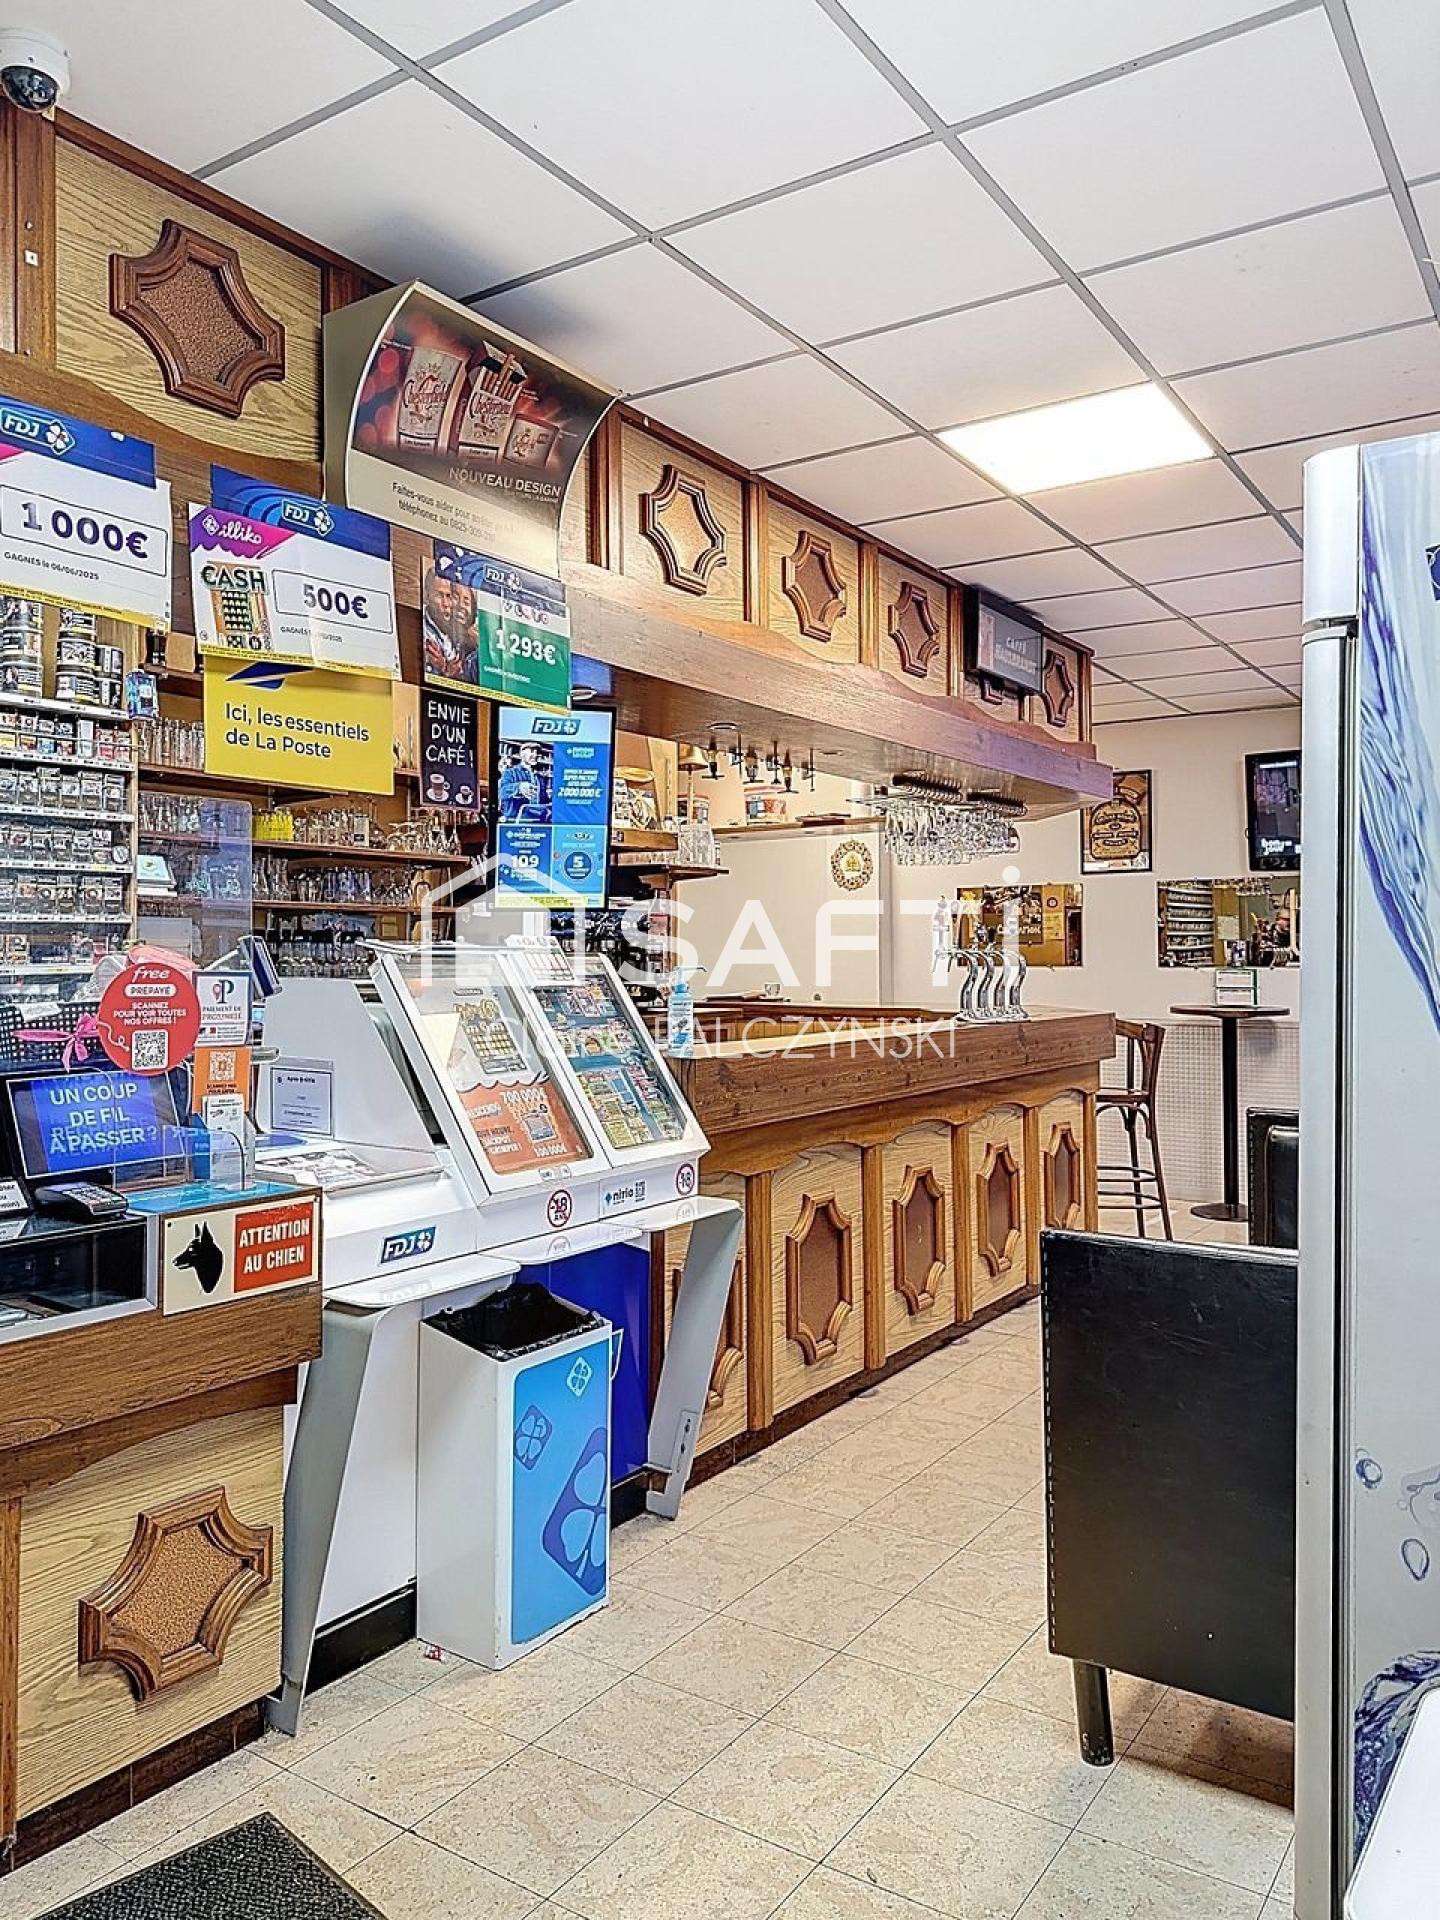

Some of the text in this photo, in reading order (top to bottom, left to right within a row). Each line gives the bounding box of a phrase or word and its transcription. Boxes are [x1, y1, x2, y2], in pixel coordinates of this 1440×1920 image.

[3, 415, 38, 436] FDJ
[451, 468, 562, 497] NOUVEAU DESIGN
[284, 505, 310, 523] FDJ
[51, 510, 148, 558] 000€
[217, 520, 262, 545] illiko
[486, 568, 505, 583] FDJ
[303, 584, 368, 619] 500€
[509, 633, 556, 666] 293€
[226, 702, 370, 742] Ici, les essentiels
[428, 700, 471, 724] ENVIE
[431, 723, 466, 744] D'UN
[533, 719, 563, 733] FDJ
[226, 727, 331, 758] de La Poste
[426, 744, 466, 766] CAFÉ
[131, 965, 171, 983] free
[131, 1001, 168, 1009] SCANNEZ
[124, 1018, 141, 1026] NOS
[50, 1082, 137, 1105] UN COUP
[69, 1106, 130, 1127] DE FIL
[68, 1127, 145, 1152] PASSER
[550, 1196, 568, 1213] -18
[239, 1217, 310, 1249] ATTENTION
[243, 1244, 305, 1274] AU CHIEN
[383, 1236, 416, 1260] FDJ
